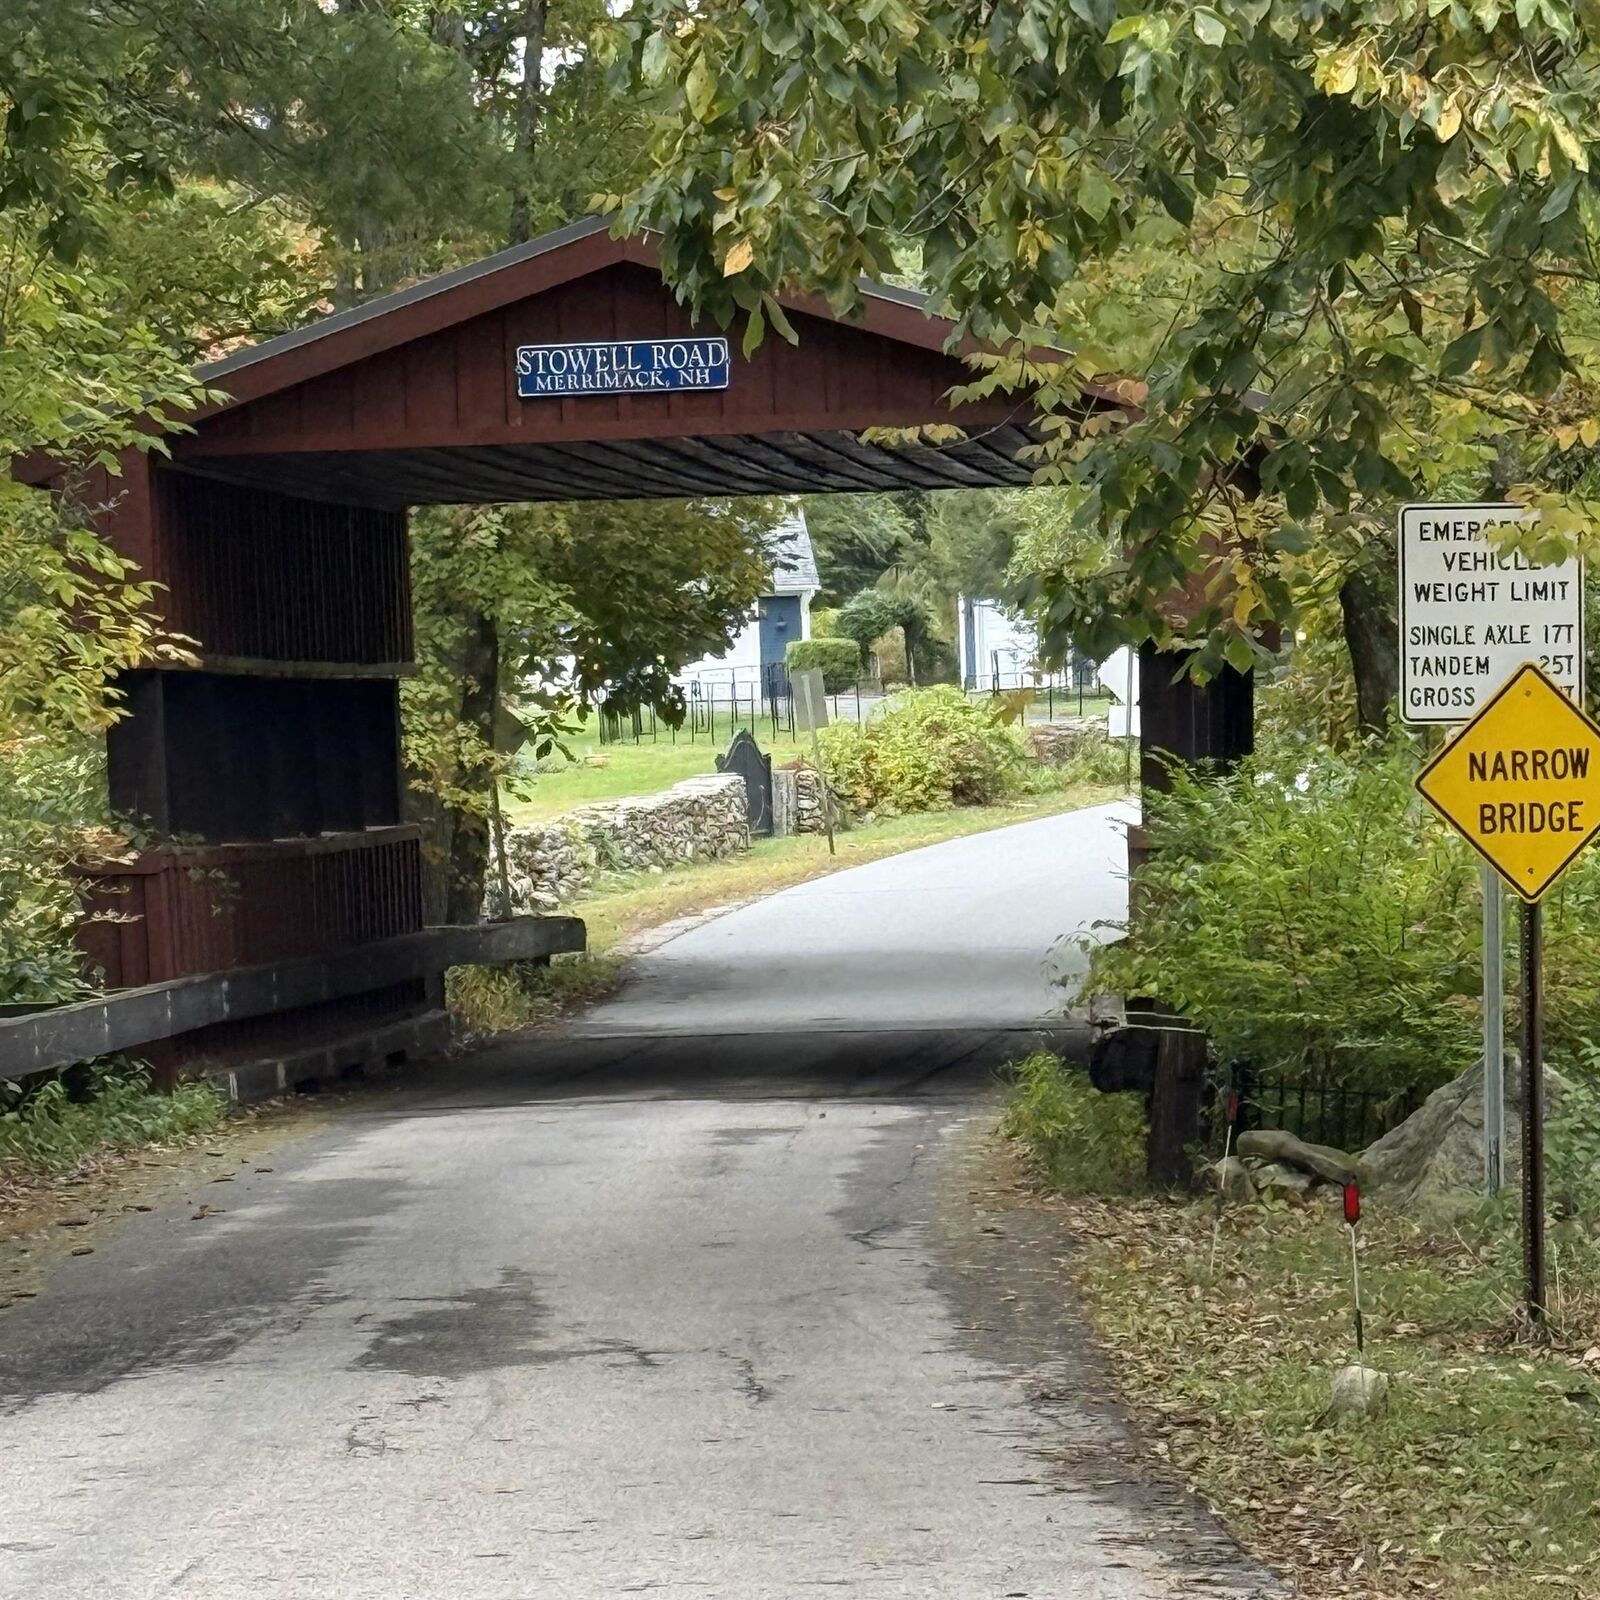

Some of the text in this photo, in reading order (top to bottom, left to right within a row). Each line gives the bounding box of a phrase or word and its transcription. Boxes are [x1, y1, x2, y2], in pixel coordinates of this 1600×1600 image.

[517, 342, 727, 375] STOWELL ROAD
[535, 369, 710, 391] MERRIMACK, NH
[1414, 581, 1570, 602] WEIGHT LIMIT
[1409, 624, 1574, 646] SINGLE AXLE 17T
[1410, 654, 1574, 677] TANDEM 25T
[1409, 687, 1476, 707] GROSS
[1469, 748, 1590, 782] NARROW
[1479, 801, 1584, 834] BRIDGE
